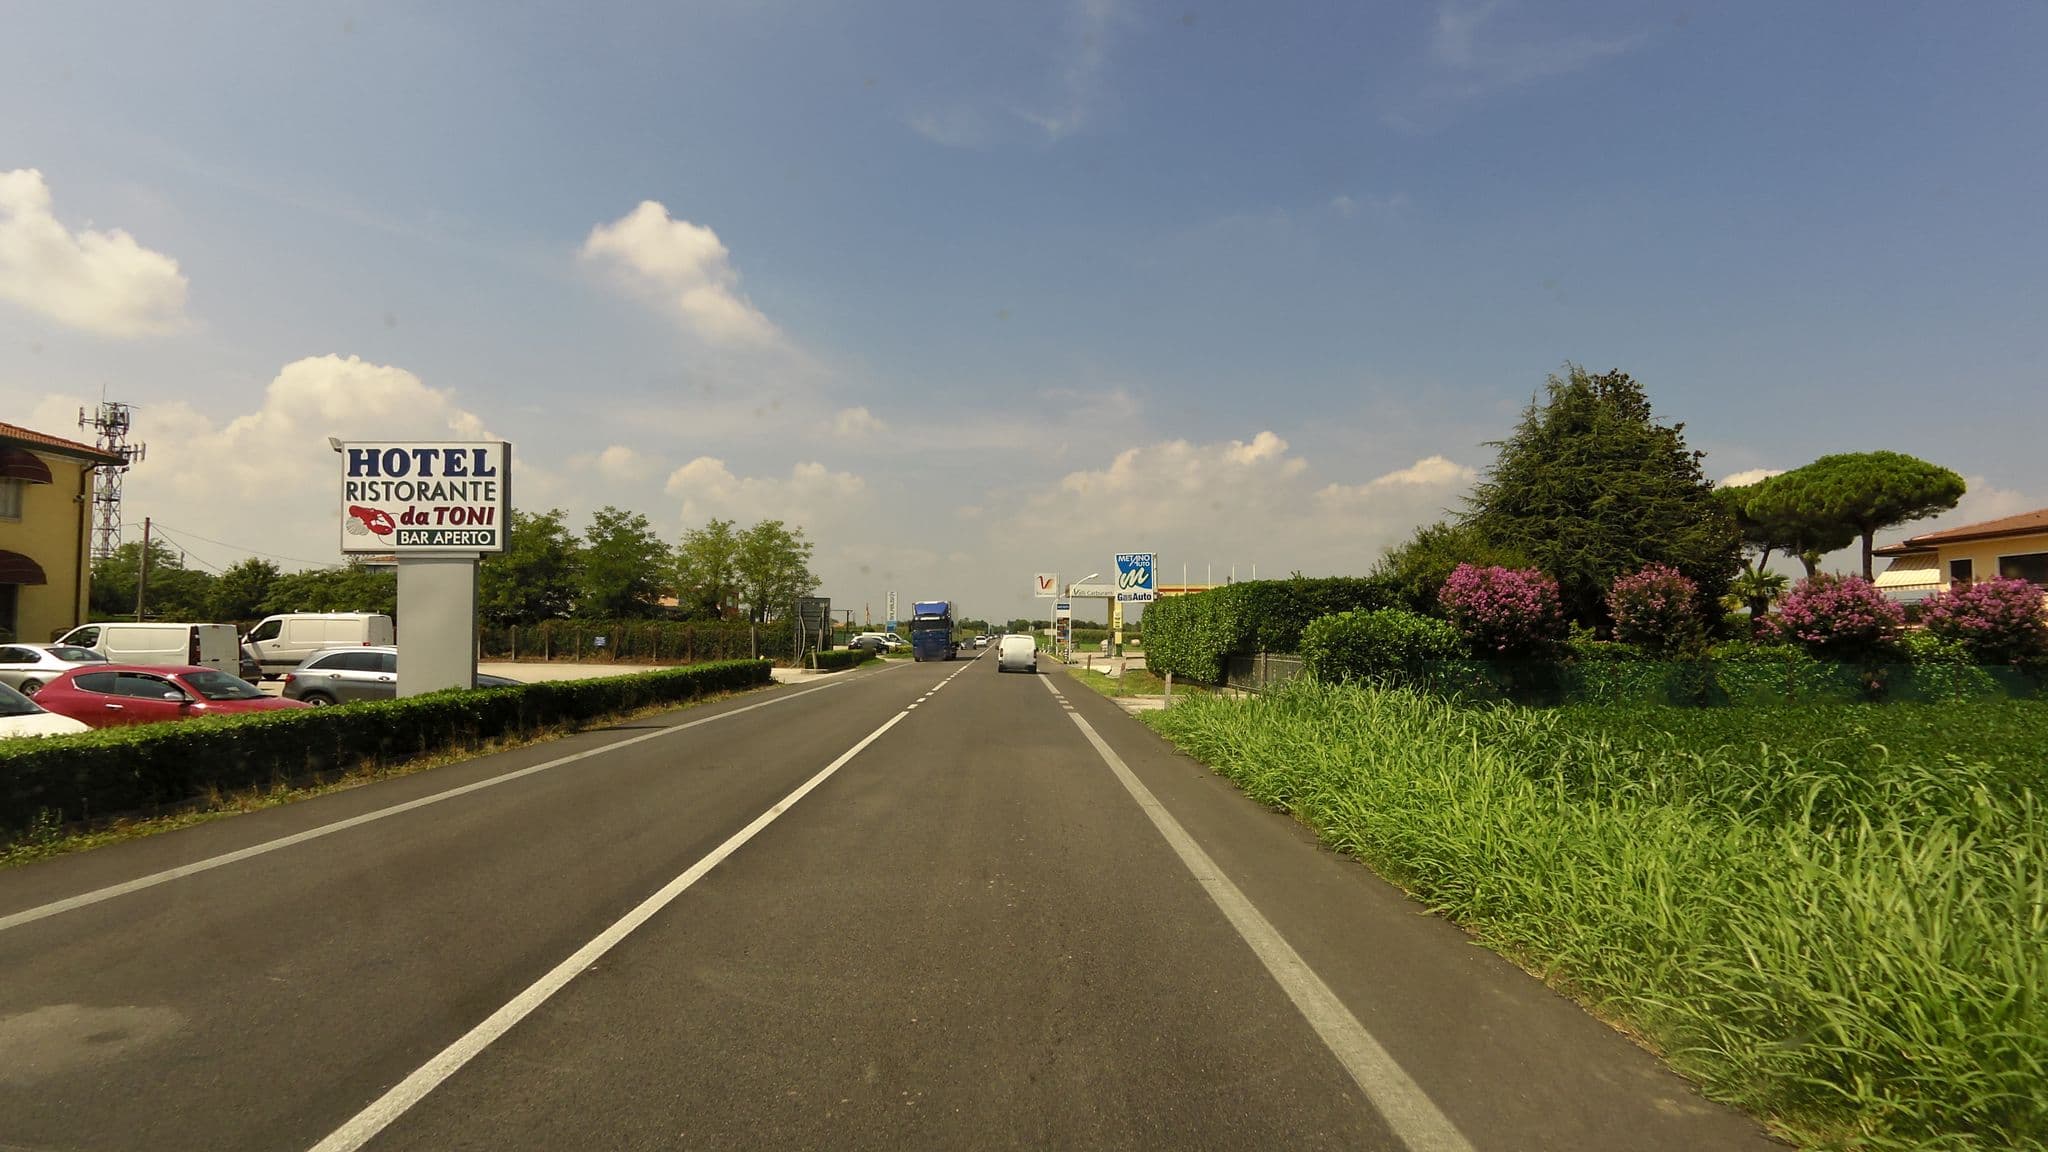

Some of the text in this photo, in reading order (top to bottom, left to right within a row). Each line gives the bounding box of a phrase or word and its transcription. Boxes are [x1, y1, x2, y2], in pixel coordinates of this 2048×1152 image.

[347, 448, 497, 477] HOTEL
[346, 481, 496, 502] RISTORANTE
[400, 505, 495, 525] da TONI
[401, 531, 491, 544] BAR APERTO
[1118, 555, 1150, 563] METANO
